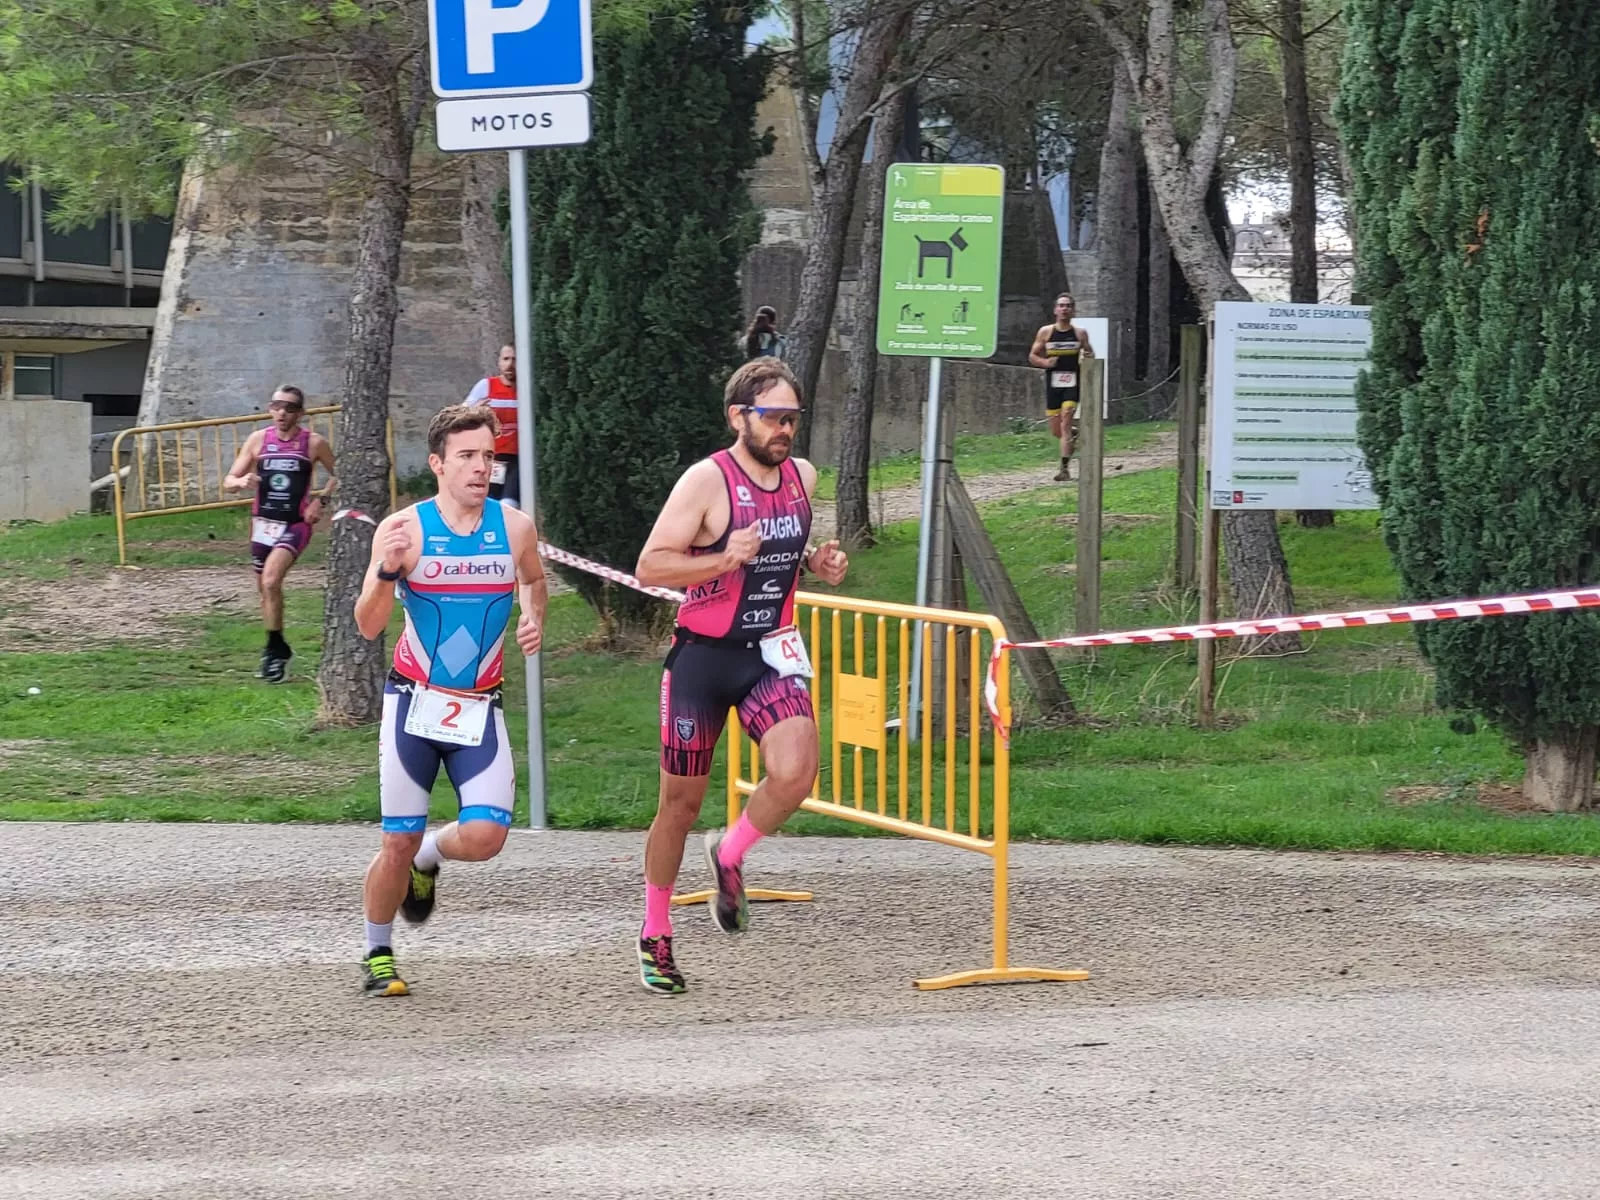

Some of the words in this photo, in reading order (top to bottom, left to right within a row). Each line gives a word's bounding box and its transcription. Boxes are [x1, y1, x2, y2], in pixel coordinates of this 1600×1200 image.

[463, 0, 551, 75] P
[471, 112, 553, 132] MOTOS
[1268, 307, 1296, 318] ZONA
[1299, 308, 1311, 318] DE
[1237, 322, 1270, 331] NORMAS
[1271, 323, 1282, 331] DE
[1282, 323, 1298, 331] USO
[443, 560, 506, 577] cabberty
[753, 563, 791, 573] Zaratecno
[440, 701, 462, 729] 2
